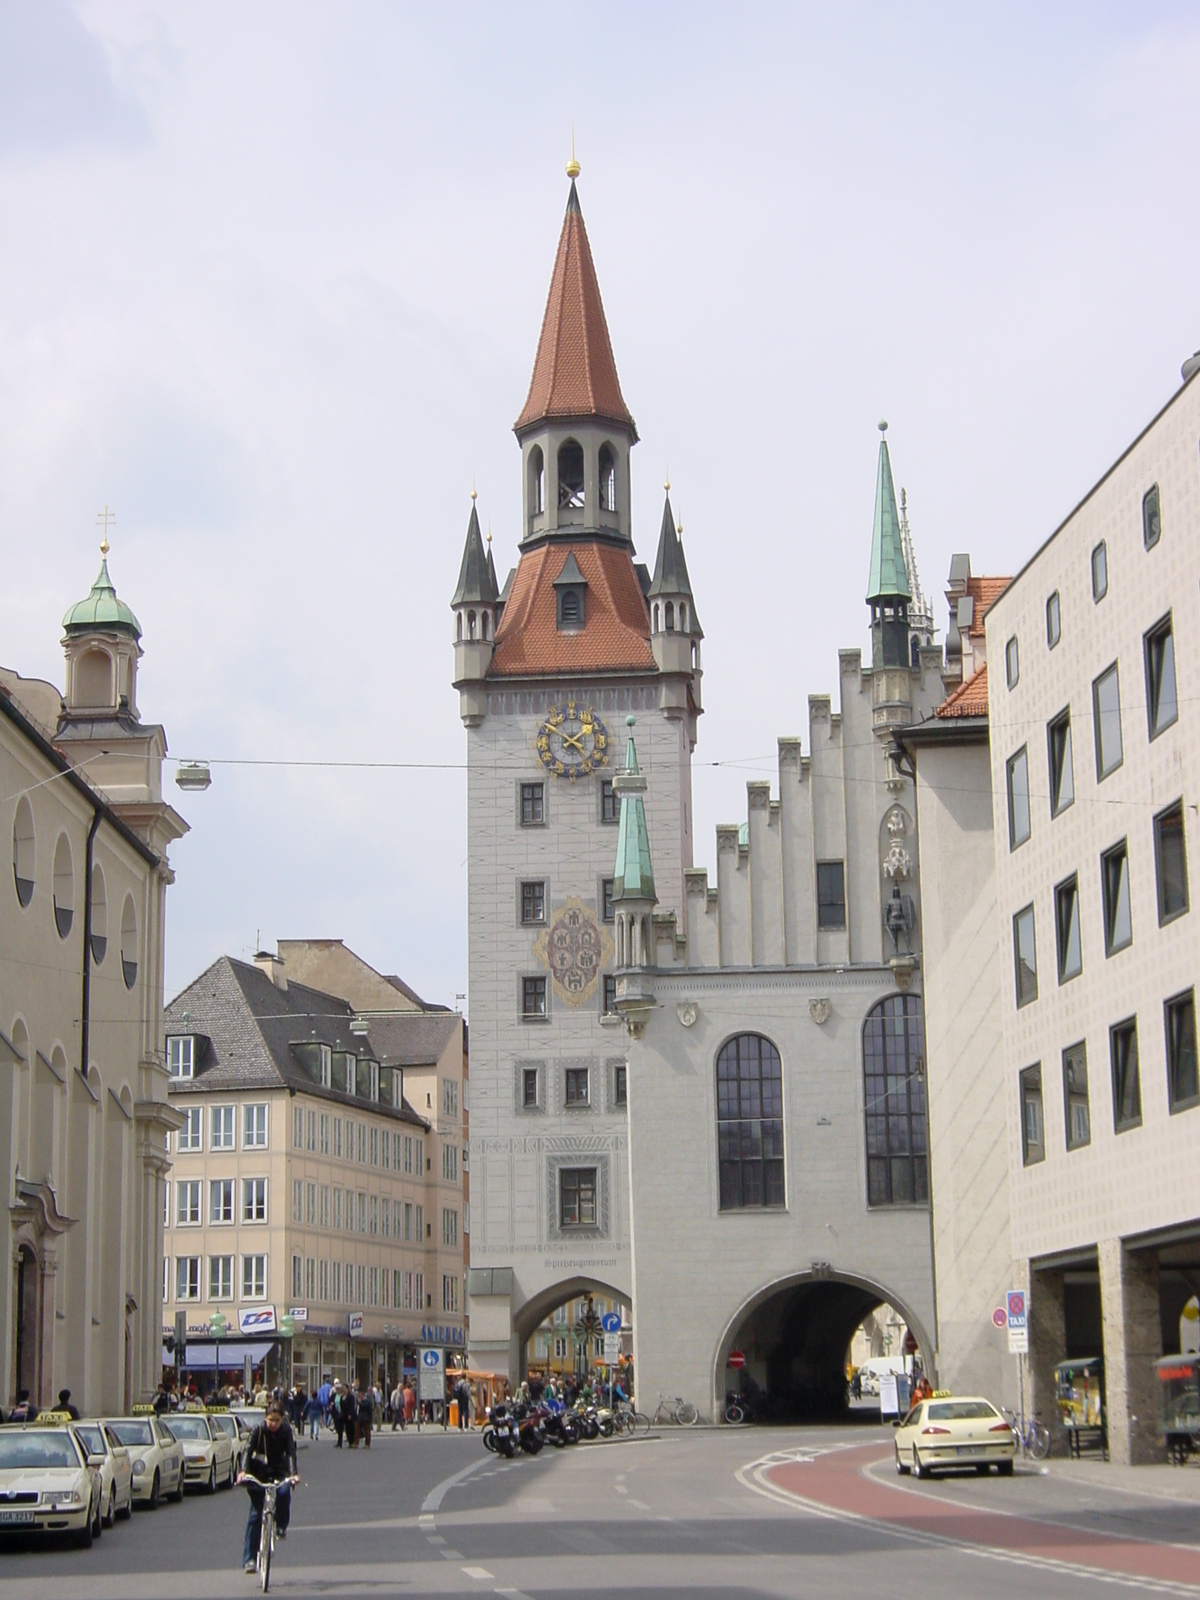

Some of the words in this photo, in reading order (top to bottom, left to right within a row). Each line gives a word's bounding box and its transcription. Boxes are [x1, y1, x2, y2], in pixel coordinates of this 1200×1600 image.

[242, 1311, 274, 1327] D2
[351, 1316, 363, 1329] D2
[1009, 1316, 1026, 1327] TAXI
[40, 1413, 64, 1421] TAXI
